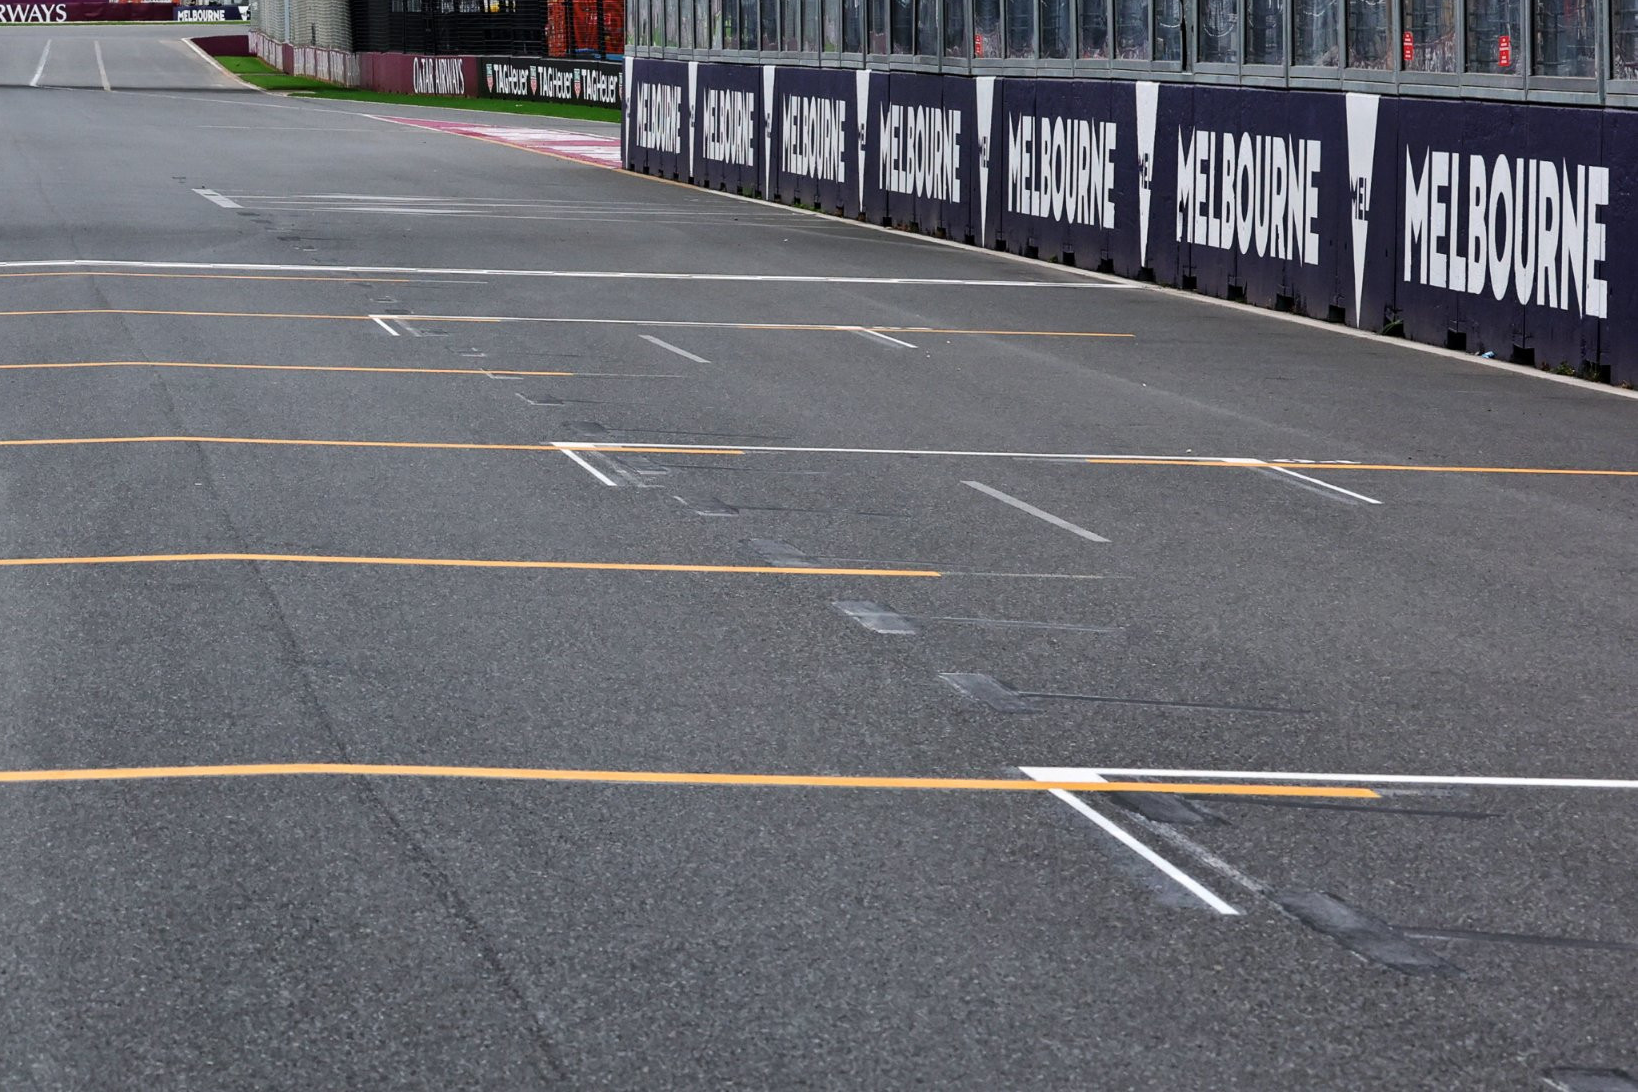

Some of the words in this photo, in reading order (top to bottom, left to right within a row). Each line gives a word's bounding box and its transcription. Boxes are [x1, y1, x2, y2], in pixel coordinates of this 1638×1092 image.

[177, 9, 226, 22] MELBOURNE
[637, 82, 682, 154] MELBOURNE
[703, 88, 755, 167] MELBOURNE
[782, 93, 846, 183] MELBOURNE
[880, 101, 962, 203] MELBOURNE
[1008, 113, 1117, 229] MELBOURNE
[1176, 124, 1322, 266] MELBOURNE
[1403, 145, 1610, 319] MELBOURNE
